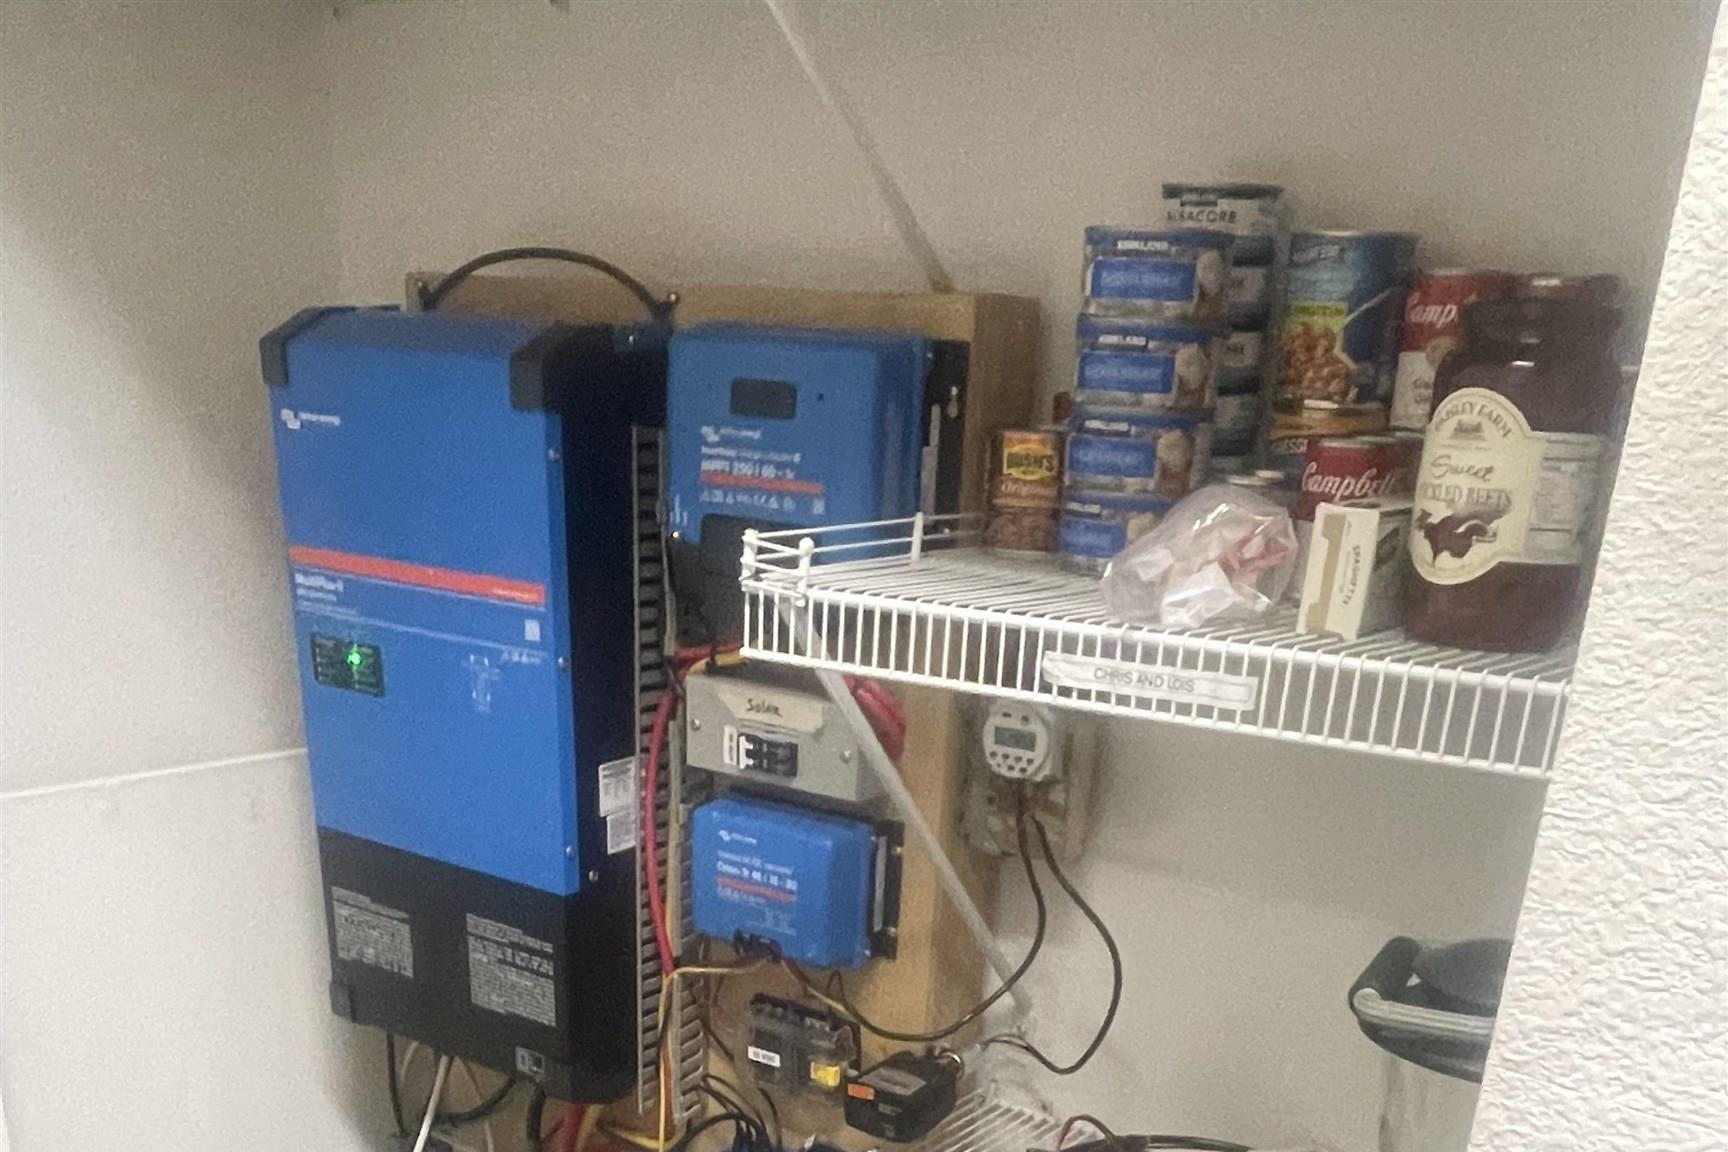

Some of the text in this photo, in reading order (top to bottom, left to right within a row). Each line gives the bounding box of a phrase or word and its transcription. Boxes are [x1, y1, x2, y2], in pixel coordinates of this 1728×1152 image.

[1431, 454, 1494, 482] Sweet
[1093, 667, 1195, 694] CHRIS AND LOIS
